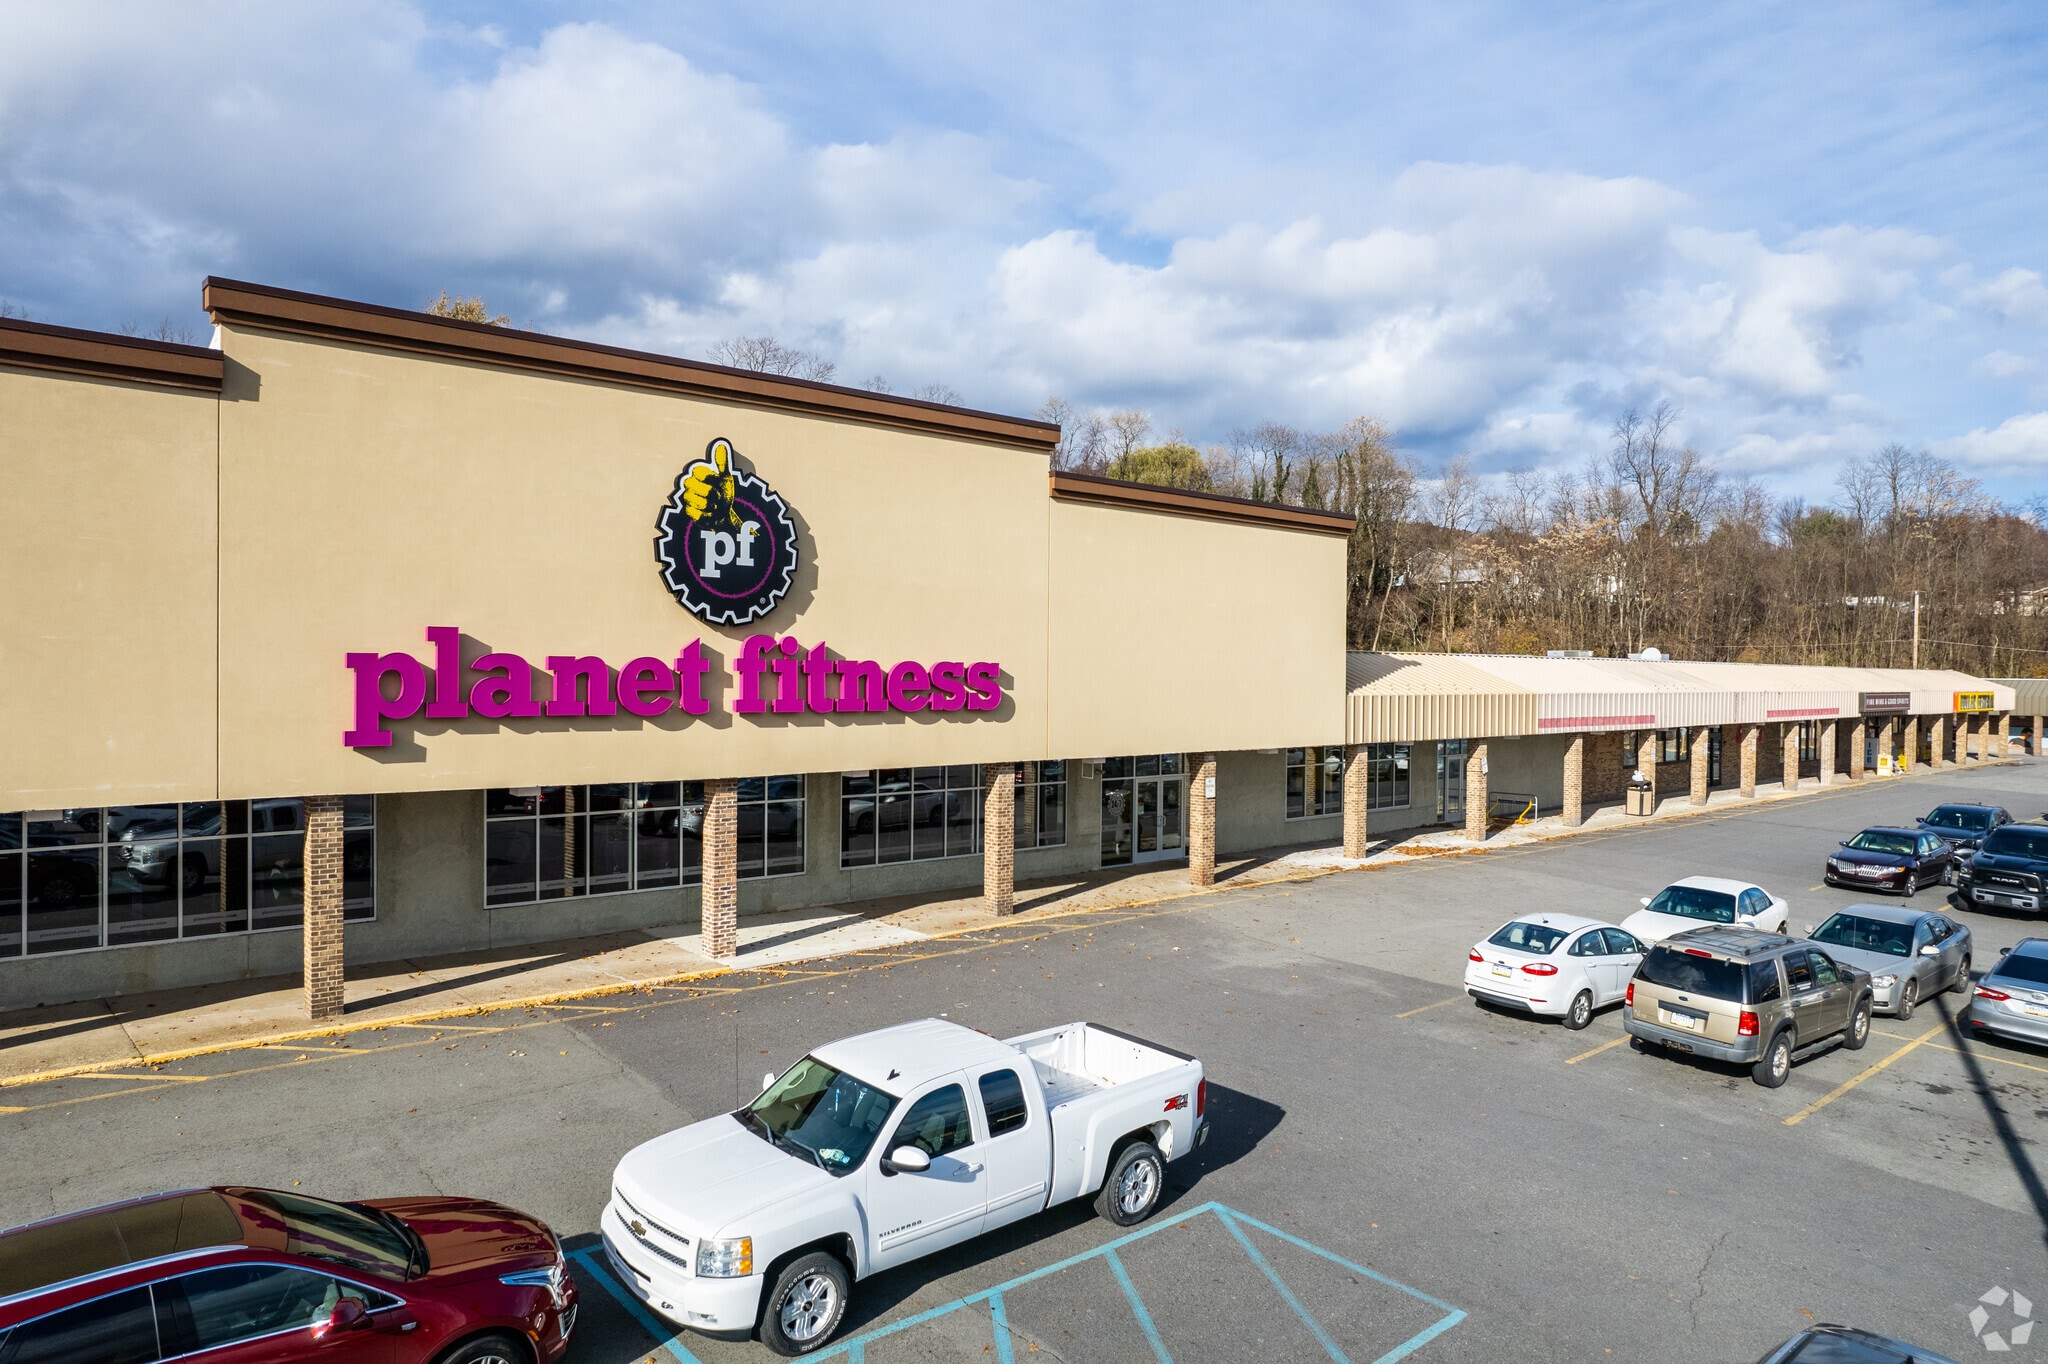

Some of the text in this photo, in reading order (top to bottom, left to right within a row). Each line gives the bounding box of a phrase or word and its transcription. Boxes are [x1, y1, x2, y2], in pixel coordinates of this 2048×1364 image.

[700, 520, 761, 578] pf
[342, 626, 1001, 747] planet fitness
[878, 1219, 922, 1238] SILVERADO
